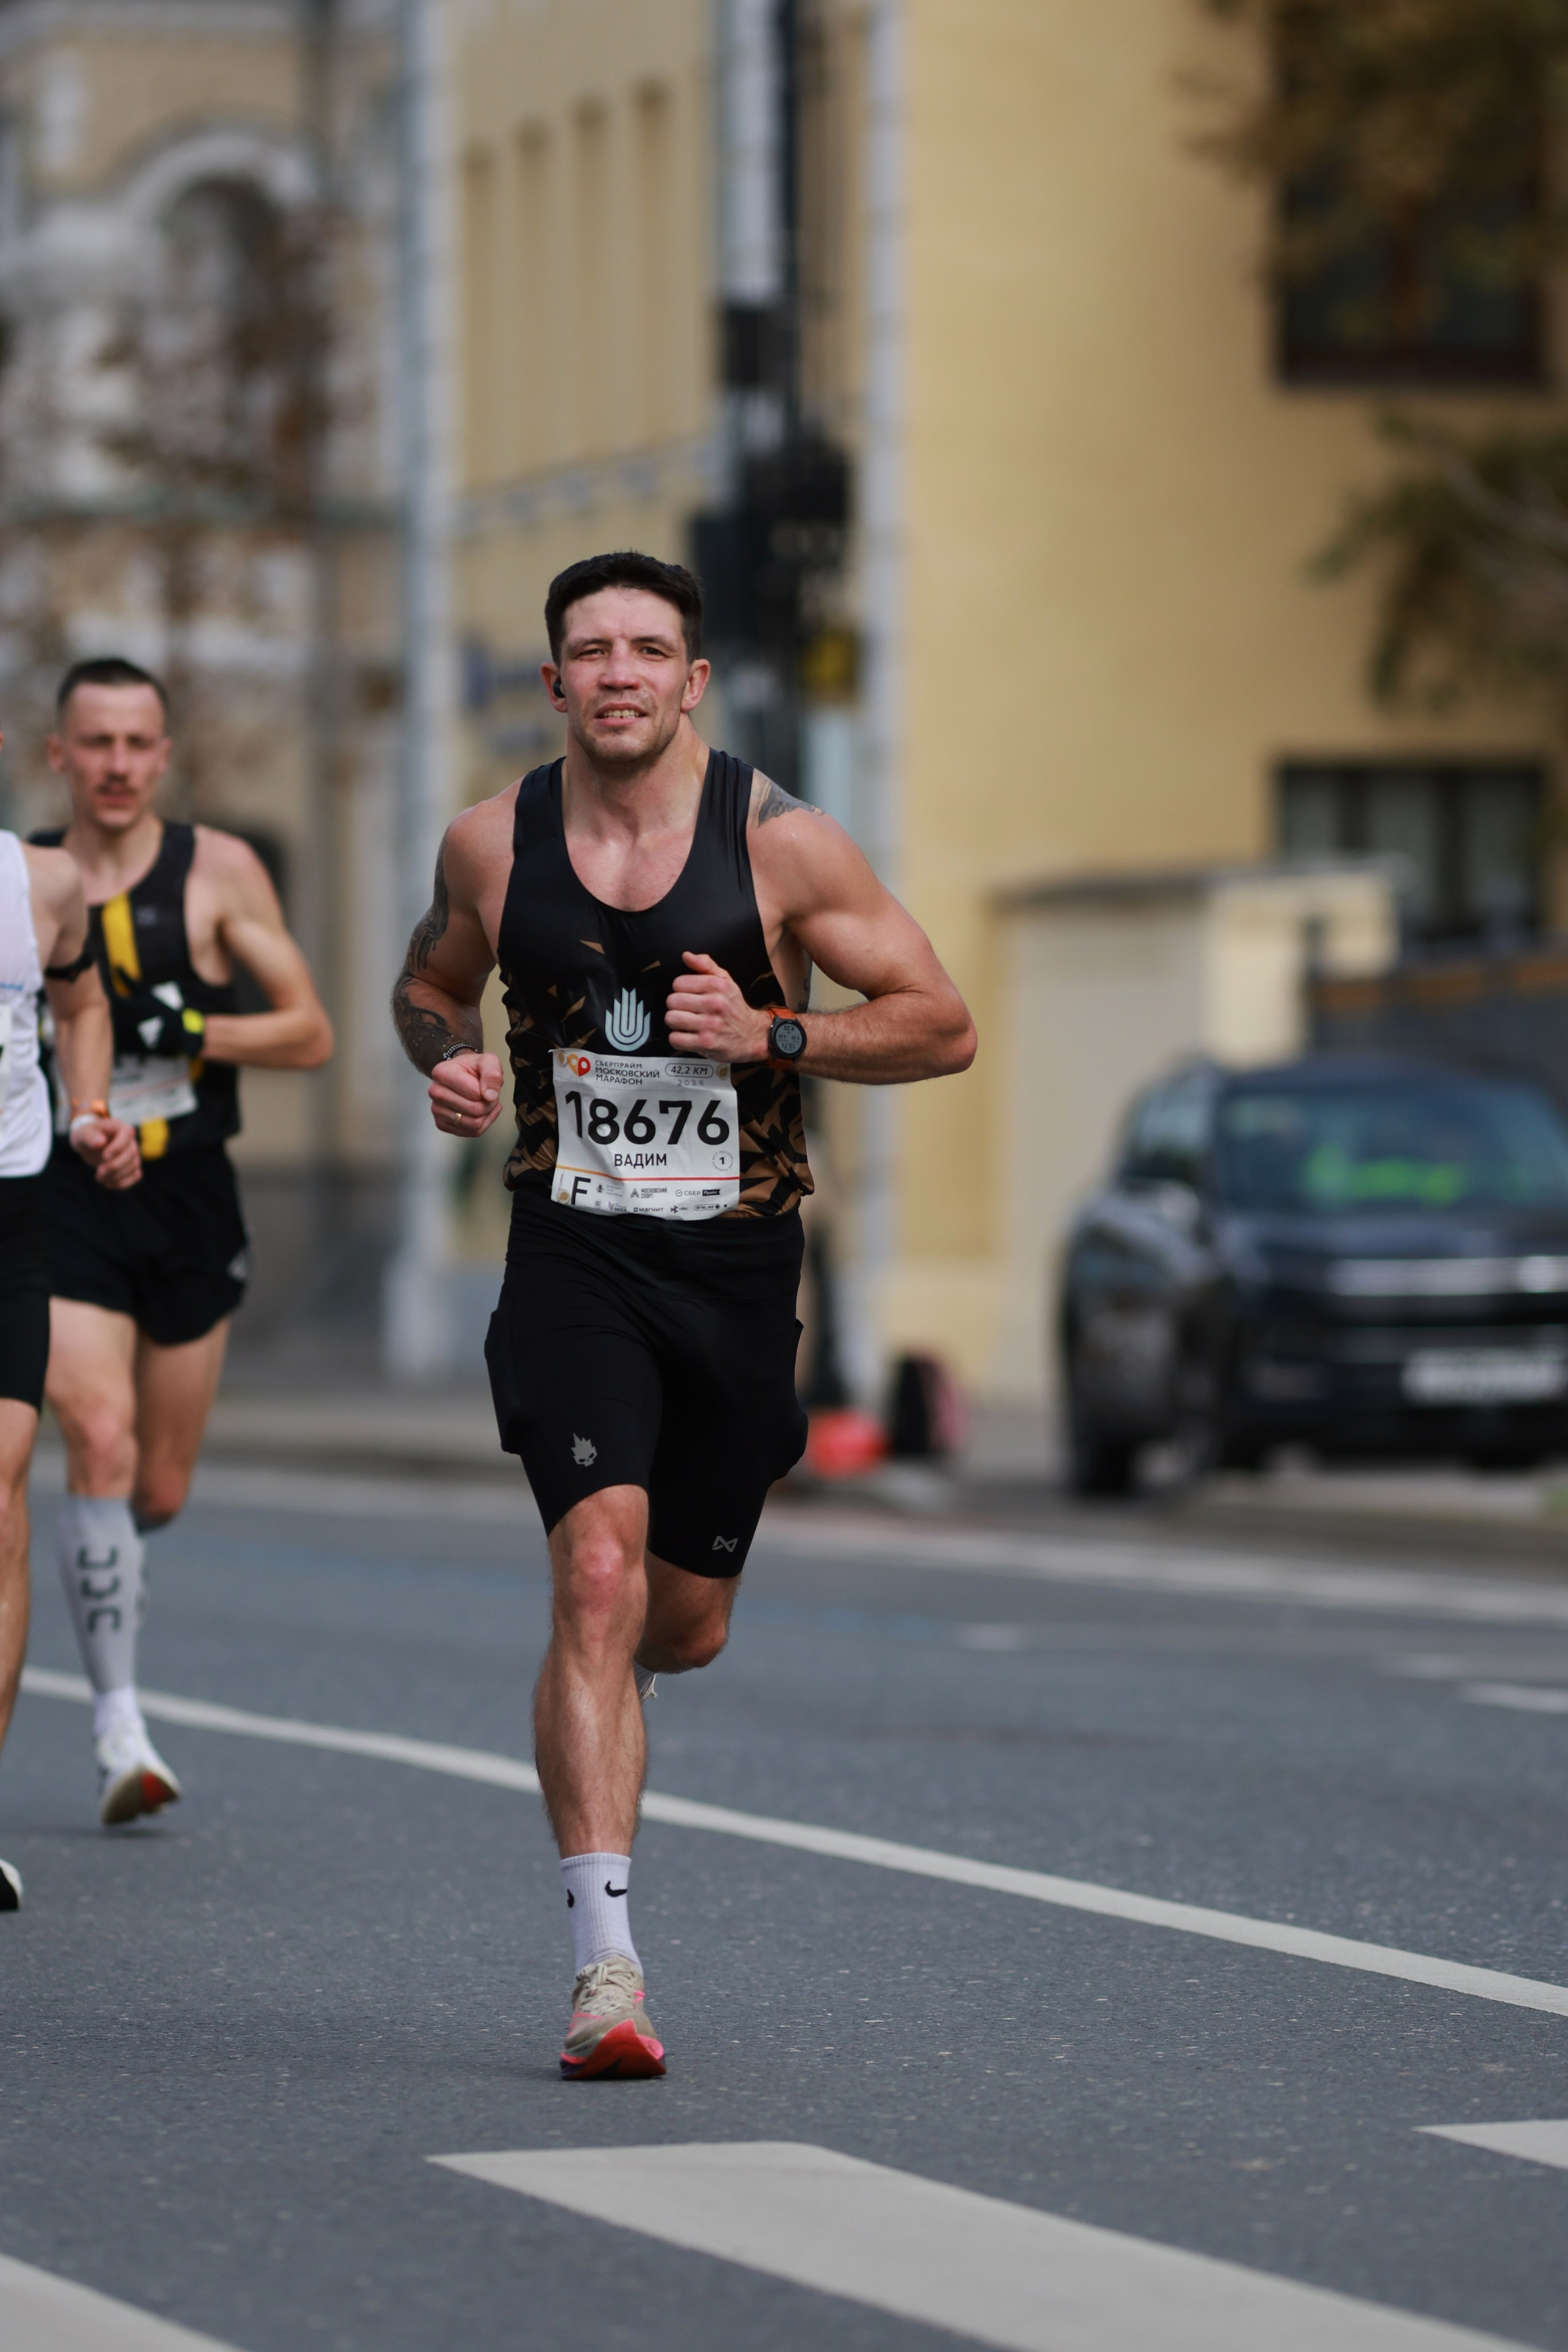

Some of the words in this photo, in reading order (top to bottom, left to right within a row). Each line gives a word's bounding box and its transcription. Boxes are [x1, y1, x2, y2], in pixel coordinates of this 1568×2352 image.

[595, 1060, 642, 1069] СБЕРПРАЙМ
[595, 1066, 660, 1078] МОСКОВСКИЙ
[671, 1066, 690, 1075] 42,2
[596, 1074, 643, 1085] МАРАФОН
[565, 1090, 729, 1145] 18676
[614, 1153, 667, 1169] ВАДИМ
[719, 1156, 725, 1165] 1
[571, 1176, 591, 1205] F
